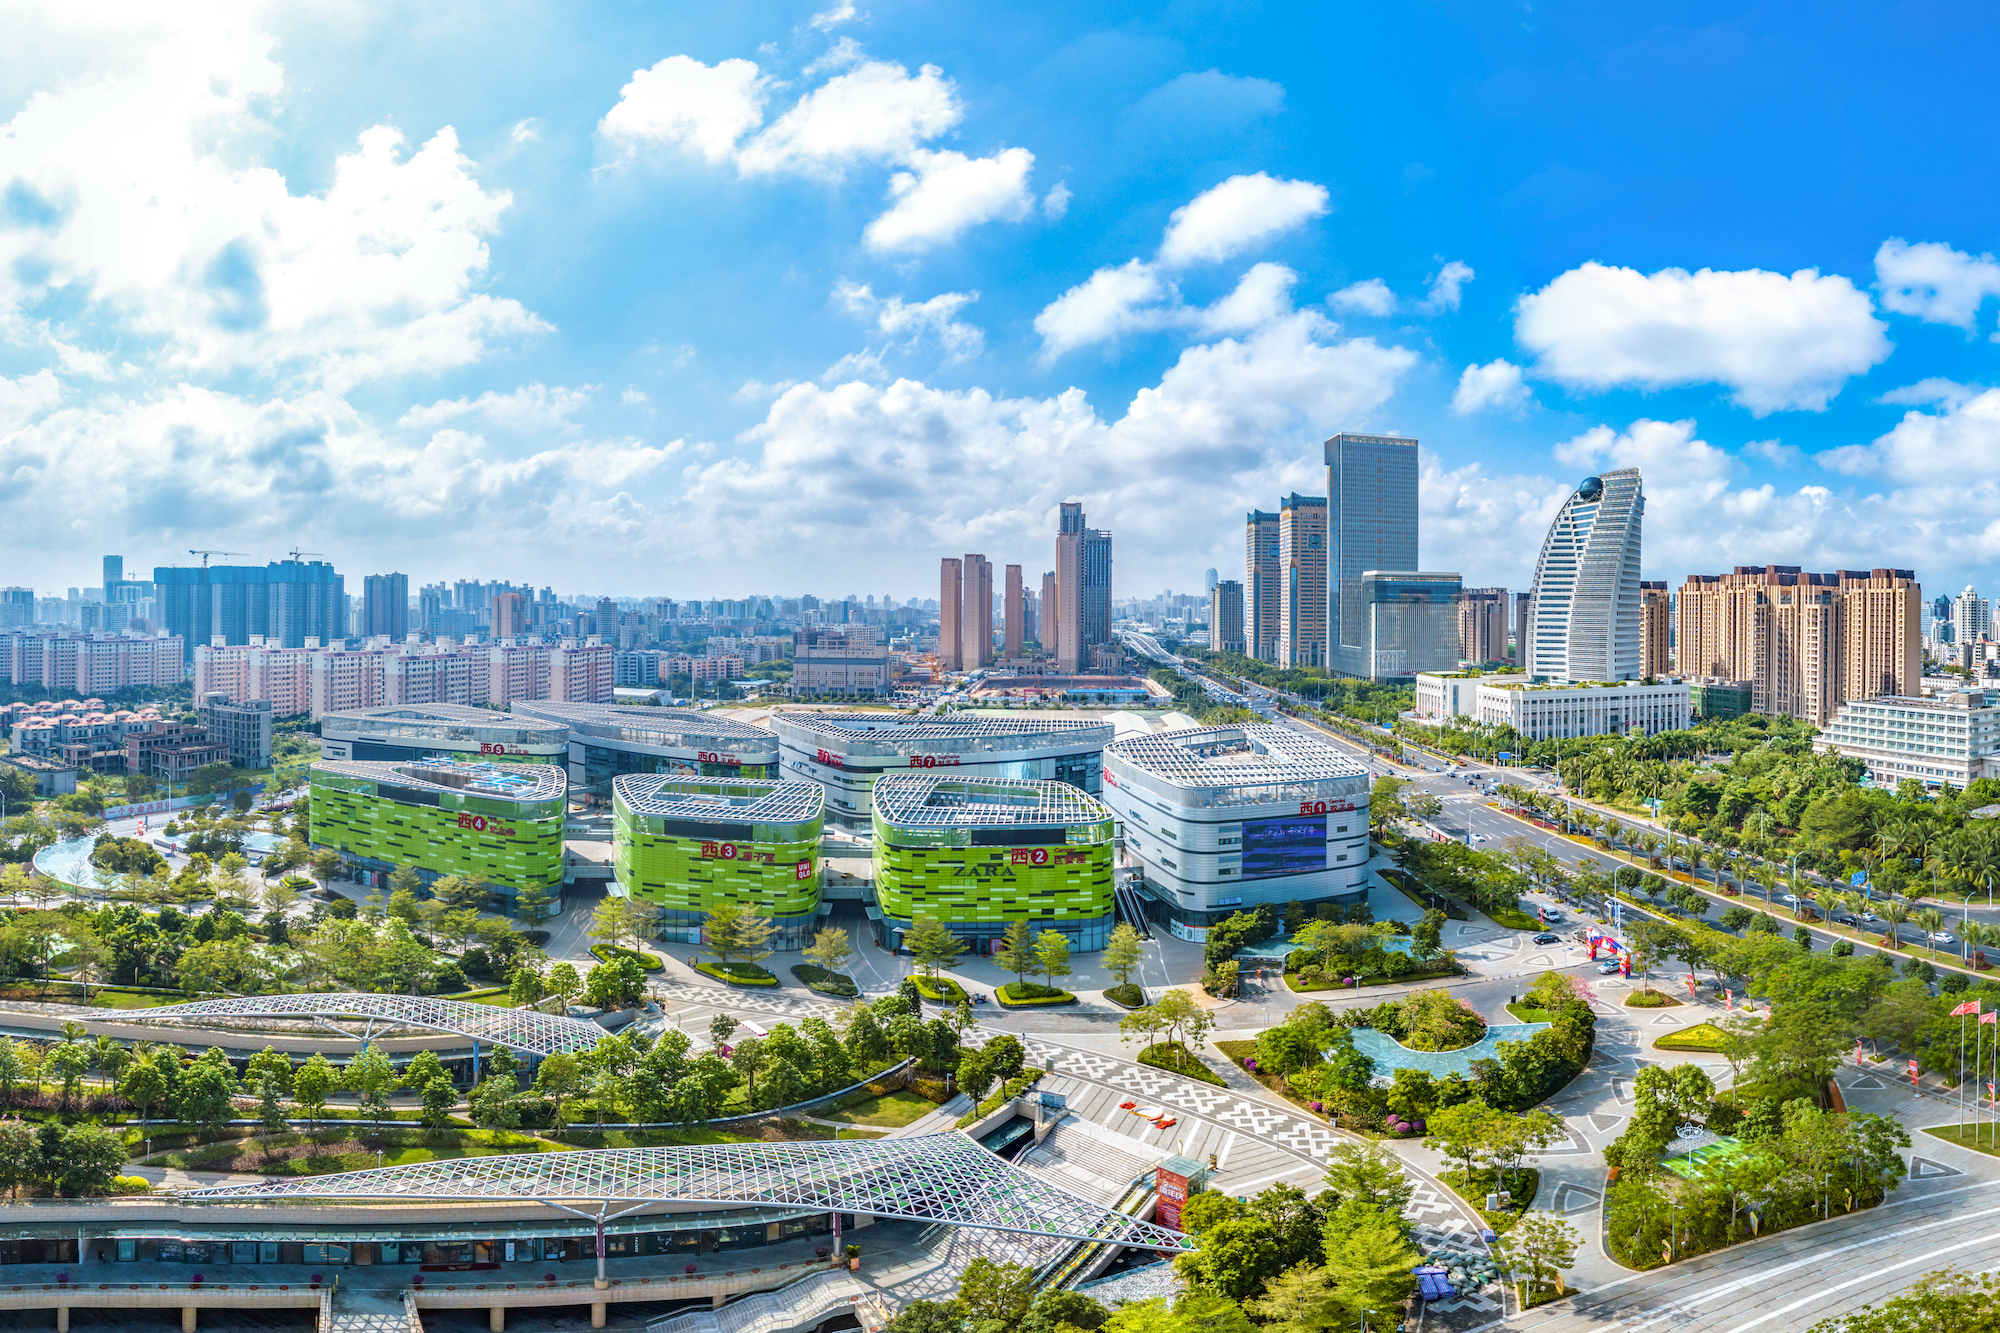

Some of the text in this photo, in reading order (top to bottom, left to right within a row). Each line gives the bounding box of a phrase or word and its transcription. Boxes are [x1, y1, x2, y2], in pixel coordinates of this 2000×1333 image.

[798, 863, 810, 871] UNI
[953, 866, 1016, 877] ZARA
[798, 870, 811, 879] QLO
